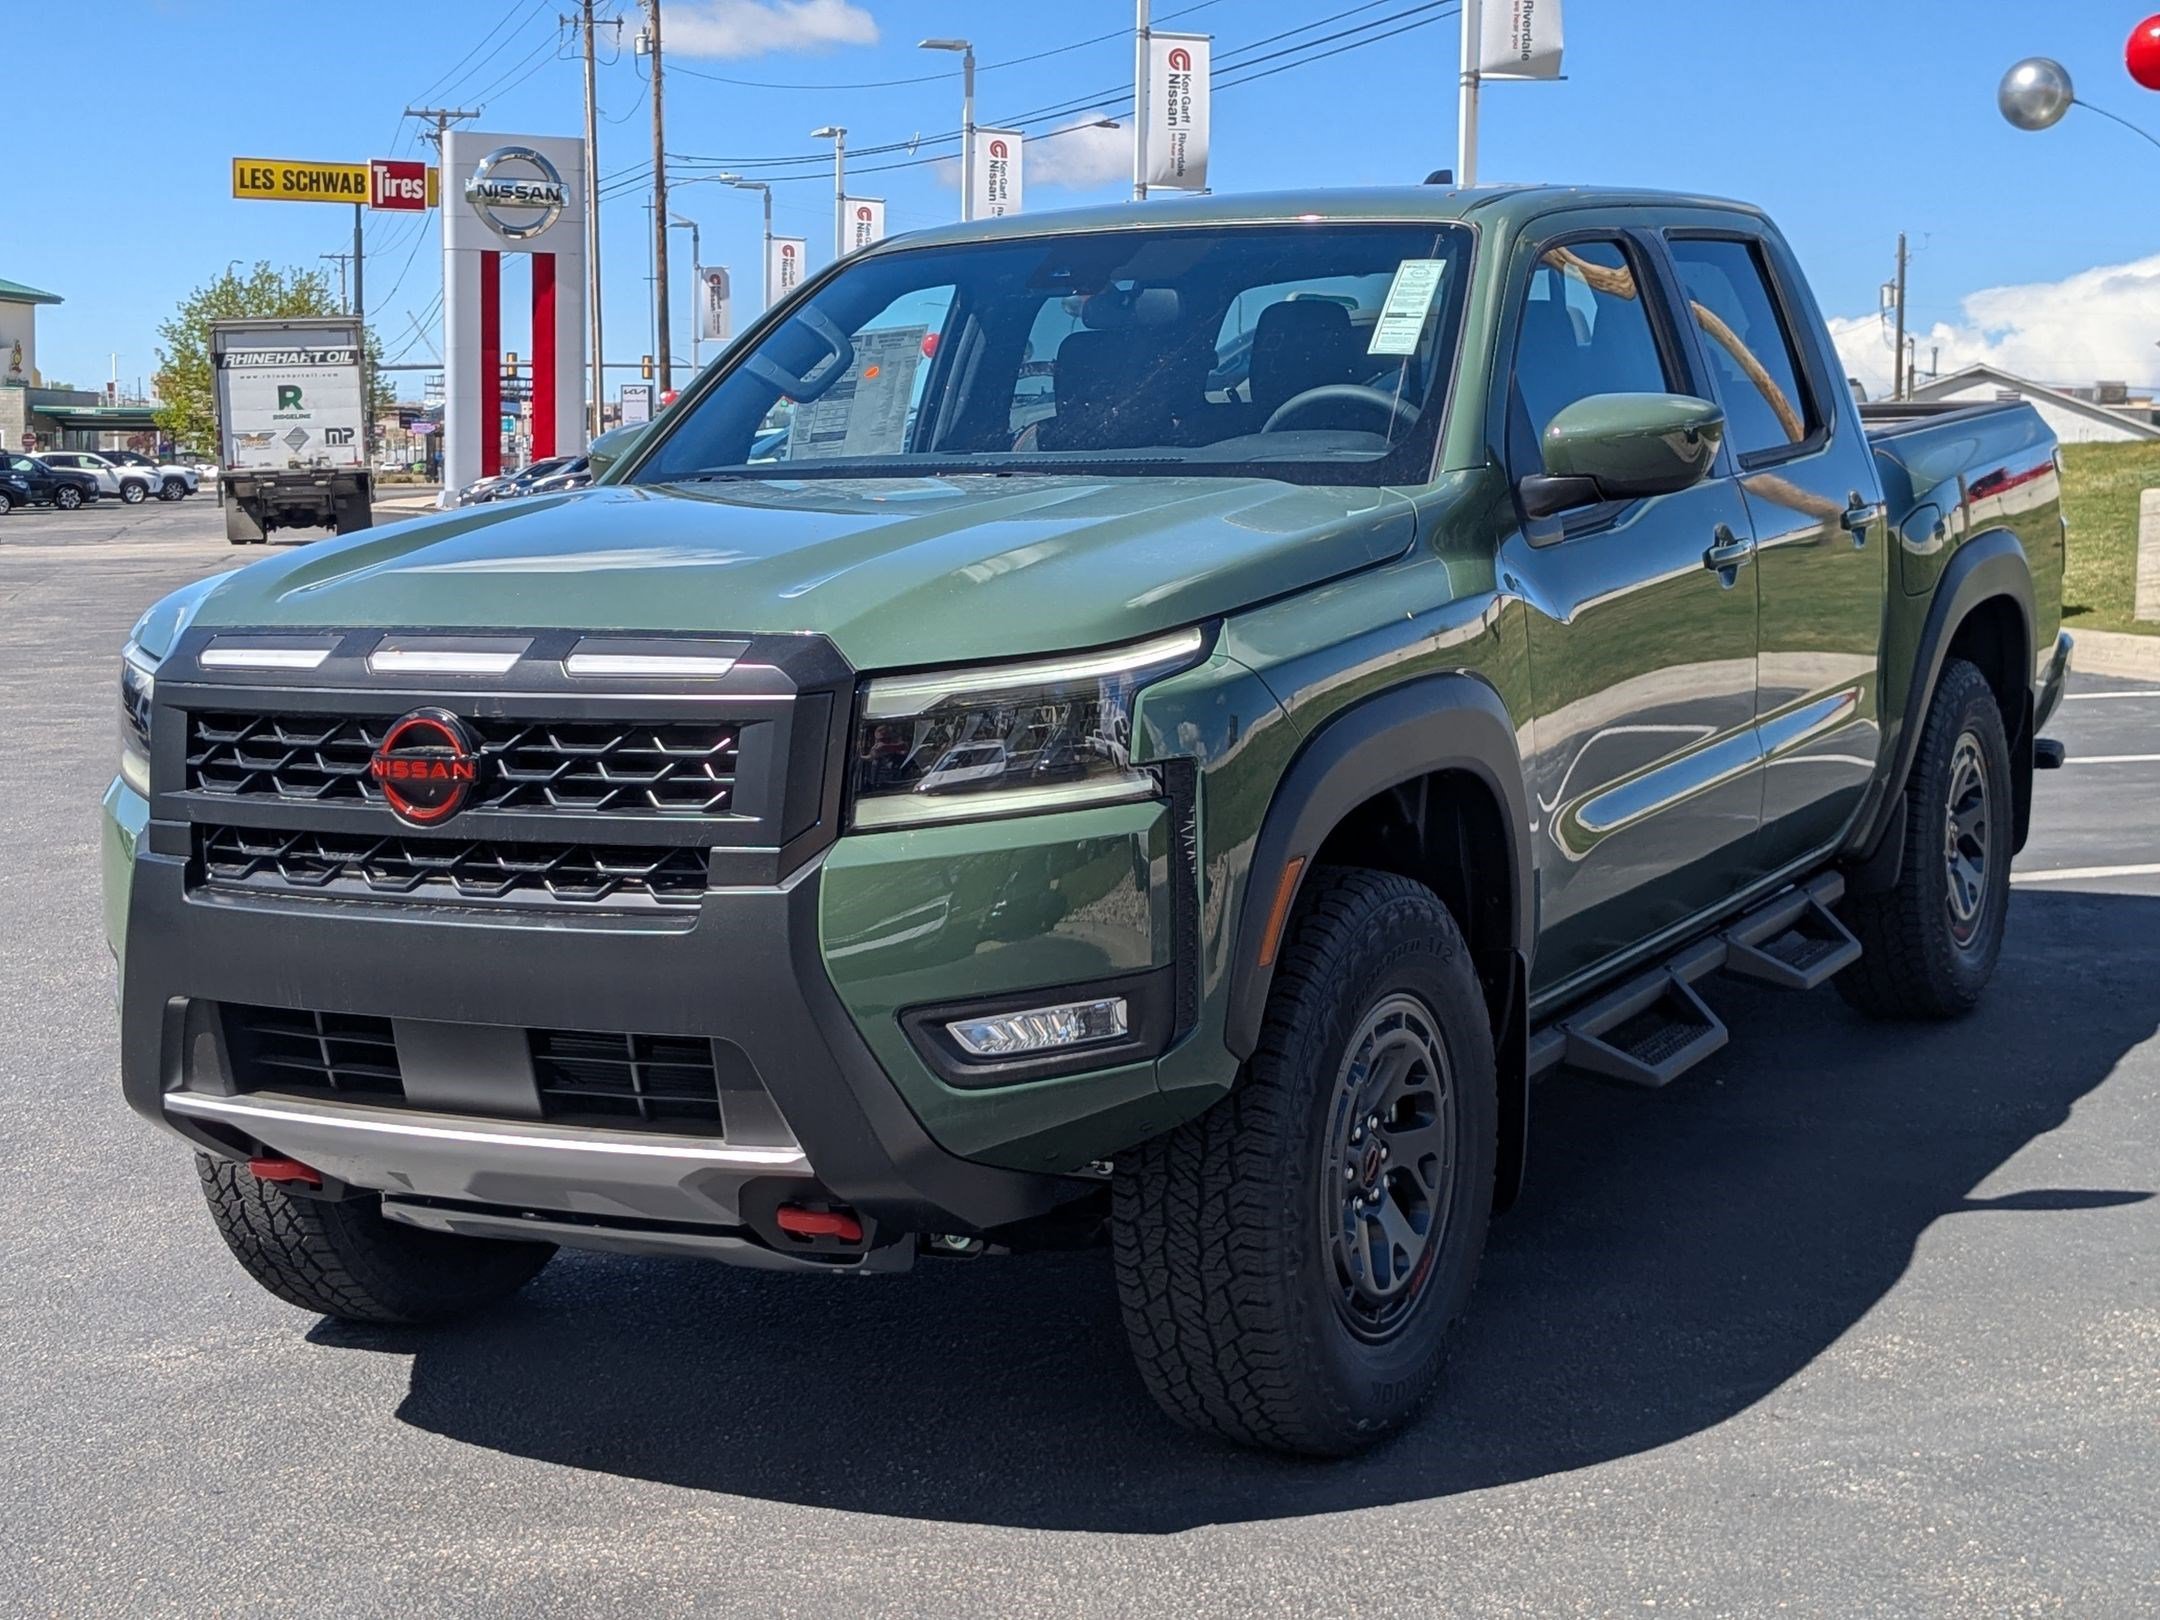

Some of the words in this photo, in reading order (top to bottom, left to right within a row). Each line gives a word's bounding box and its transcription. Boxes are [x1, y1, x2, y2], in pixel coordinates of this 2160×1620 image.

[1521, 0, 1534, 61] Riverdale
[1181, 73, 1191, 95] Ken
[1168, 73, 1181, 126] Nissan
[1180, 96, 1191, 123] Garff
[1177, 133, 1187, 177] Riverdale
[239, 167, 275, 190] LES
[282, 169, 366, 194] SCHWAB
[373, 165, 424, 204] Tires
[477, 184, 560, 201] NISSAN
[988, 160, 1000, 201] Nissan
[222, 352, 324, 368] RHINEHART
[326, 351, 354, 364] OIL
[272, 413, 312, 421] RIDGELINE
[372, 760, 474, 779] NISSAN
